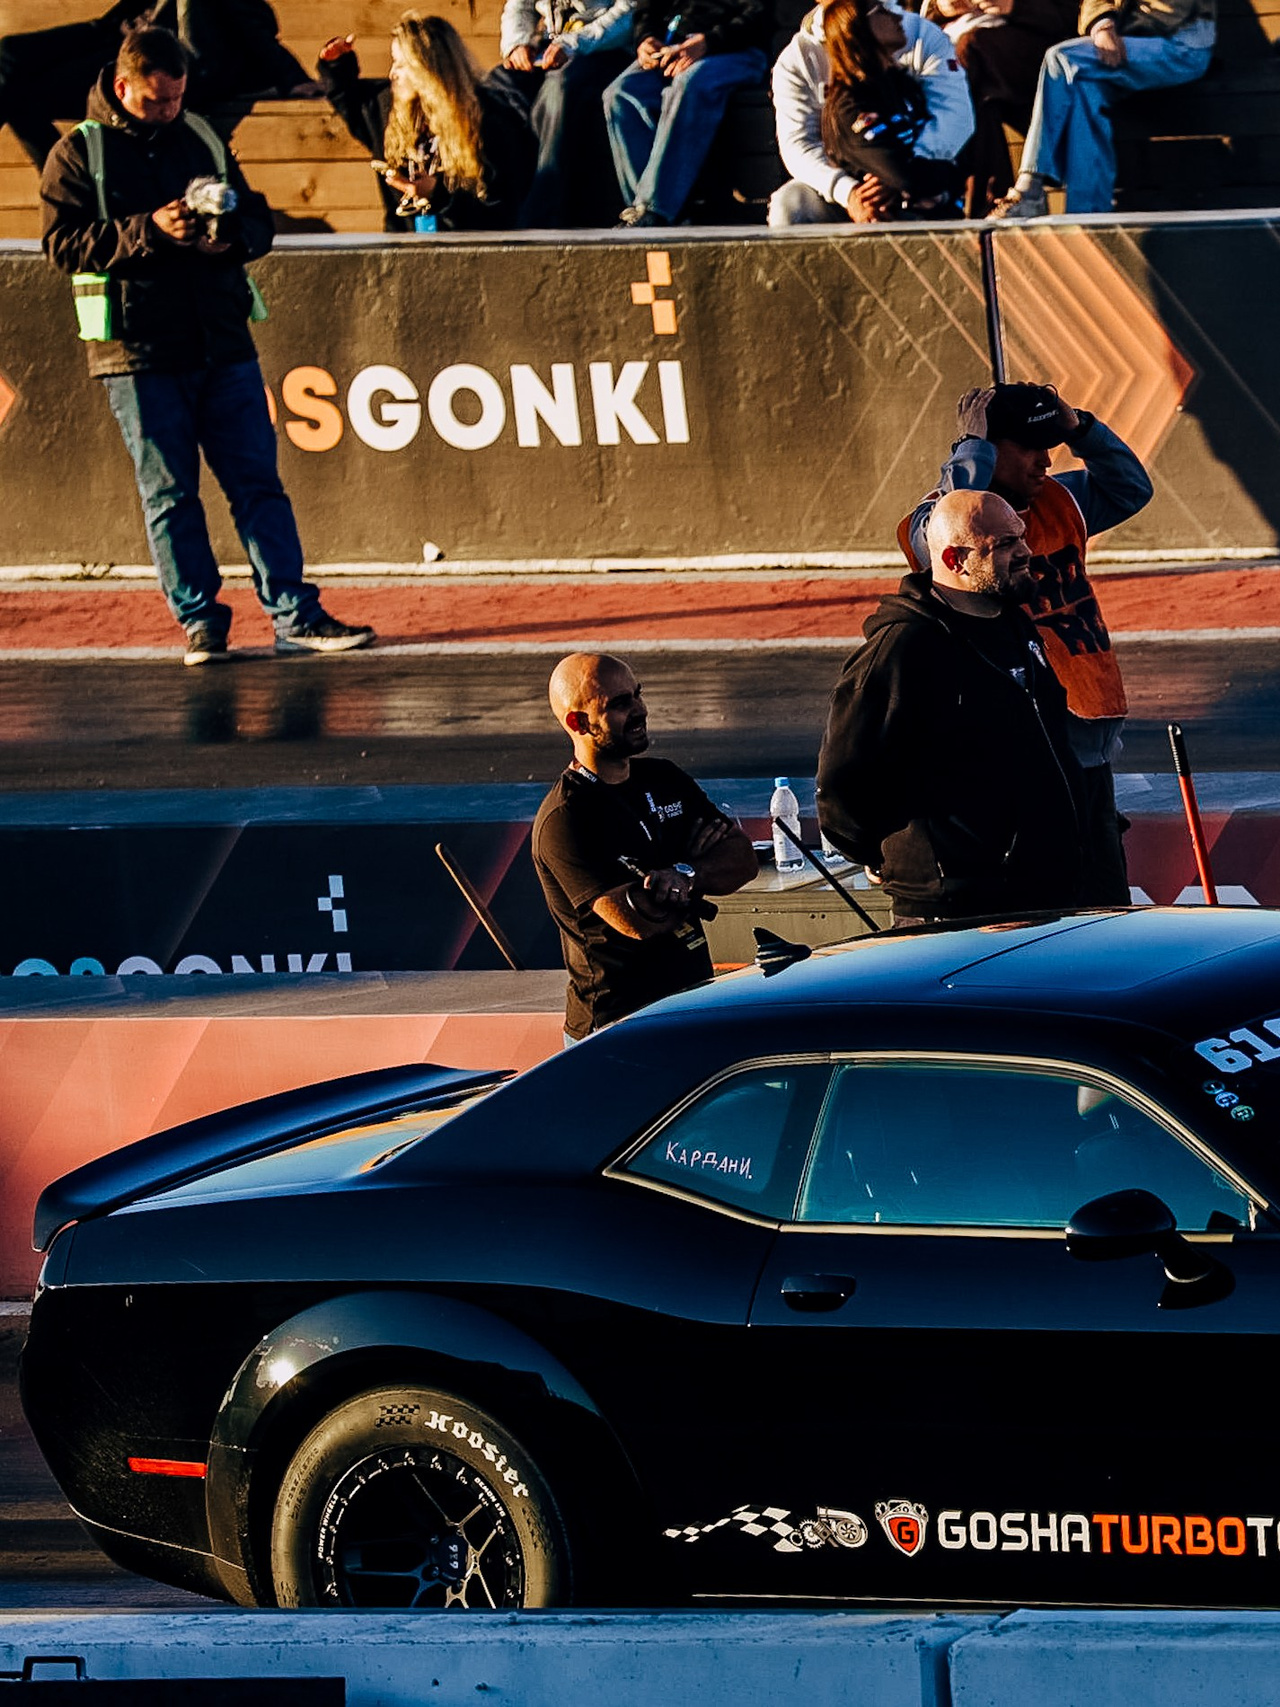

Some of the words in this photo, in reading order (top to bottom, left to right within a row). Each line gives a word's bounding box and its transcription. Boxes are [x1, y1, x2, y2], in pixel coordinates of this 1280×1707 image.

[264, 360, 691, 452] SGONKI
[424, 1410, 529, 1498] Hoosier
[474, 1476, 497, 1503] DEMON
[322, 1493, 339, 1527] WHEELS
[317, 1526, 328, 1559] POWER
